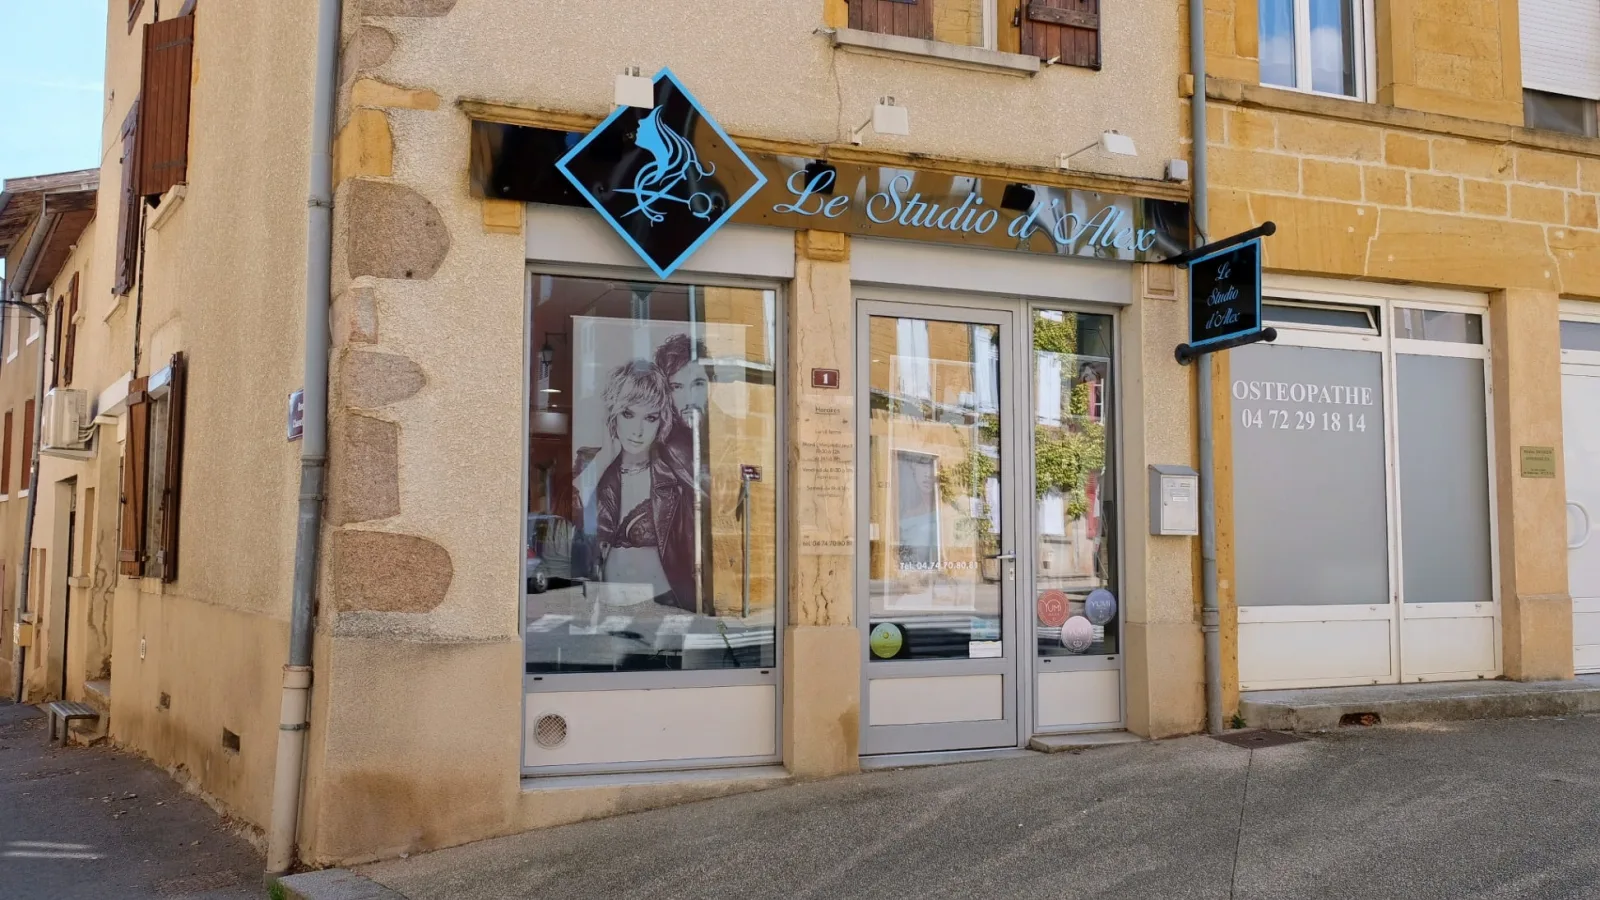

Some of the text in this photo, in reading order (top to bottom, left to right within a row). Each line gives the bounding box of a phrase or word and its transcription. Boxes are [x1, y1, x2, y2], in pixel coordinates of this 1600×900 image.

[772, 169, 1156, 252] Le Studio d'Alex
[1214, 261, 1232, 282] Le
[1207, 285, 1239, 307] Studio
[1205, 307, 1241, 330] d'Alex
[822, 373, 829, 385] 1
[1232, 380, 1373, 406] OSTEOPATHE
[1241, 408, 1367, 432] 04 72 29 18 14
